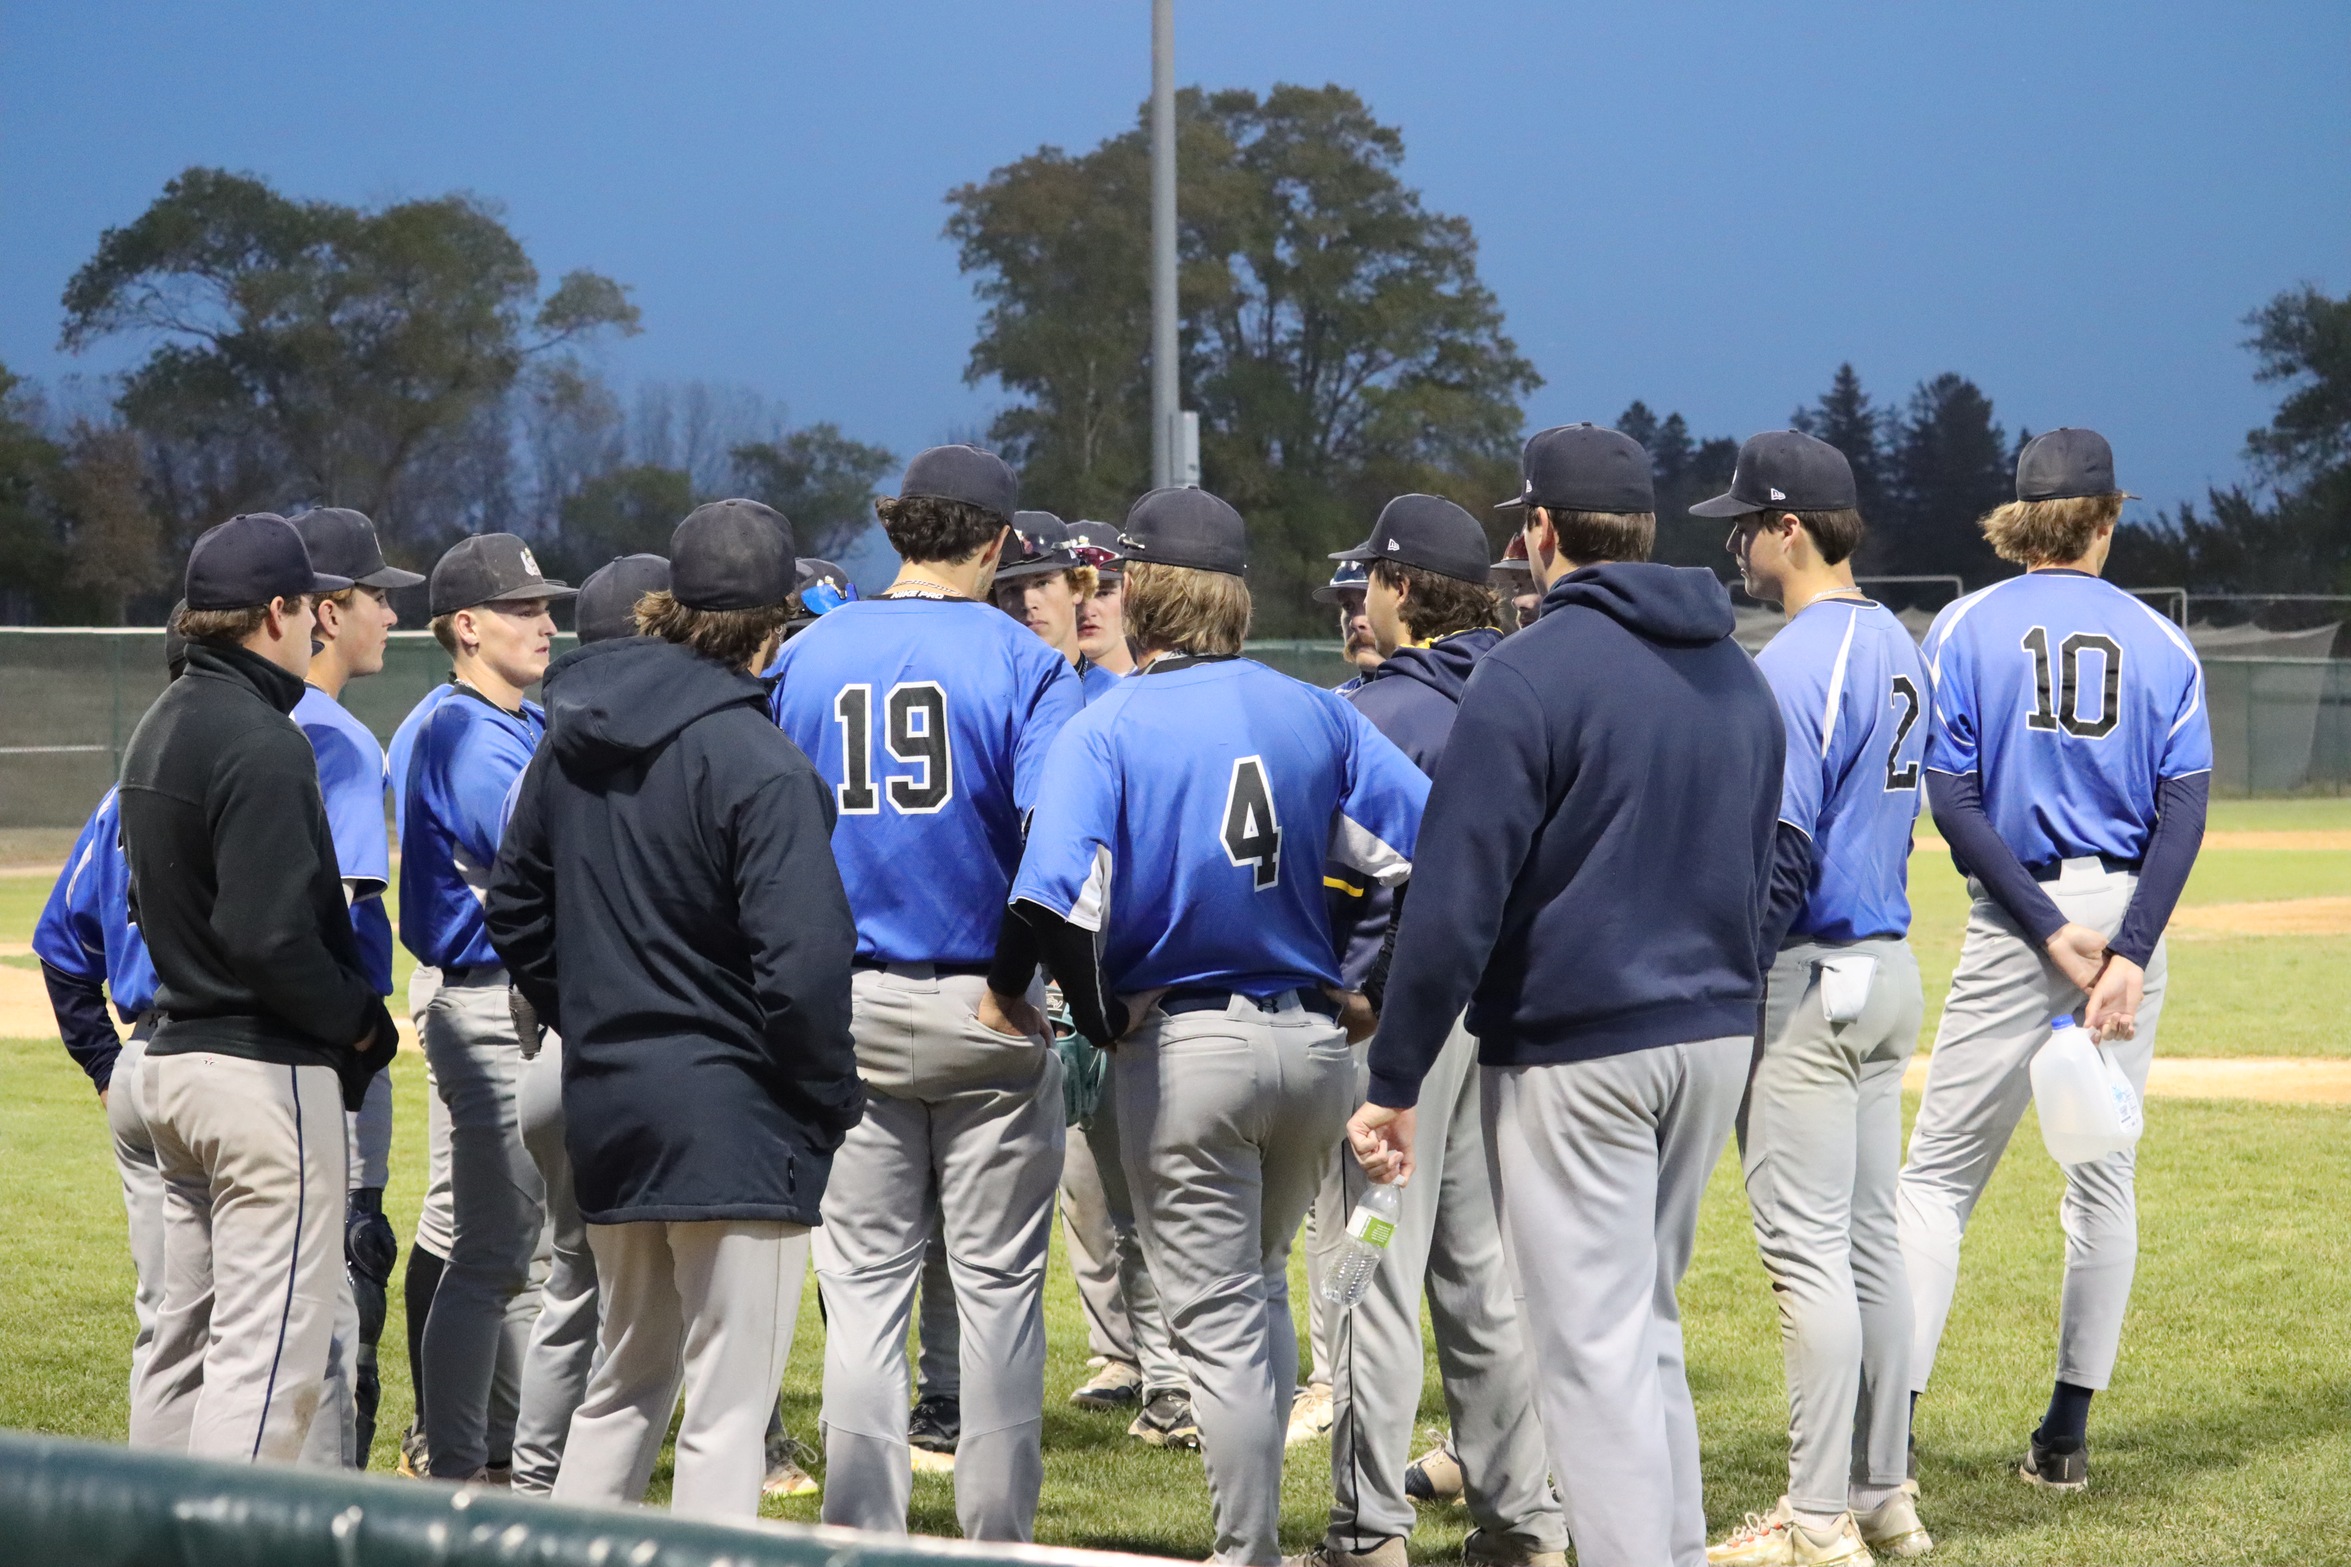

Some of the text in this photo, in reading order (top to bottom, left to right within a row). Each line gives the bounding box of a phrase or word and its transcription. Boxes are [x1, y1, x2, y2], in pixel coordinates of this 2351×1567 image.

[890, 590, 945, 600] NIKE PRO
[1883, 673, 1920, 792] 2
[2020, 625, 2123, 740] 10
[834, 680, 953, 815] 19
[1219, 754, 1282, 893] 4
